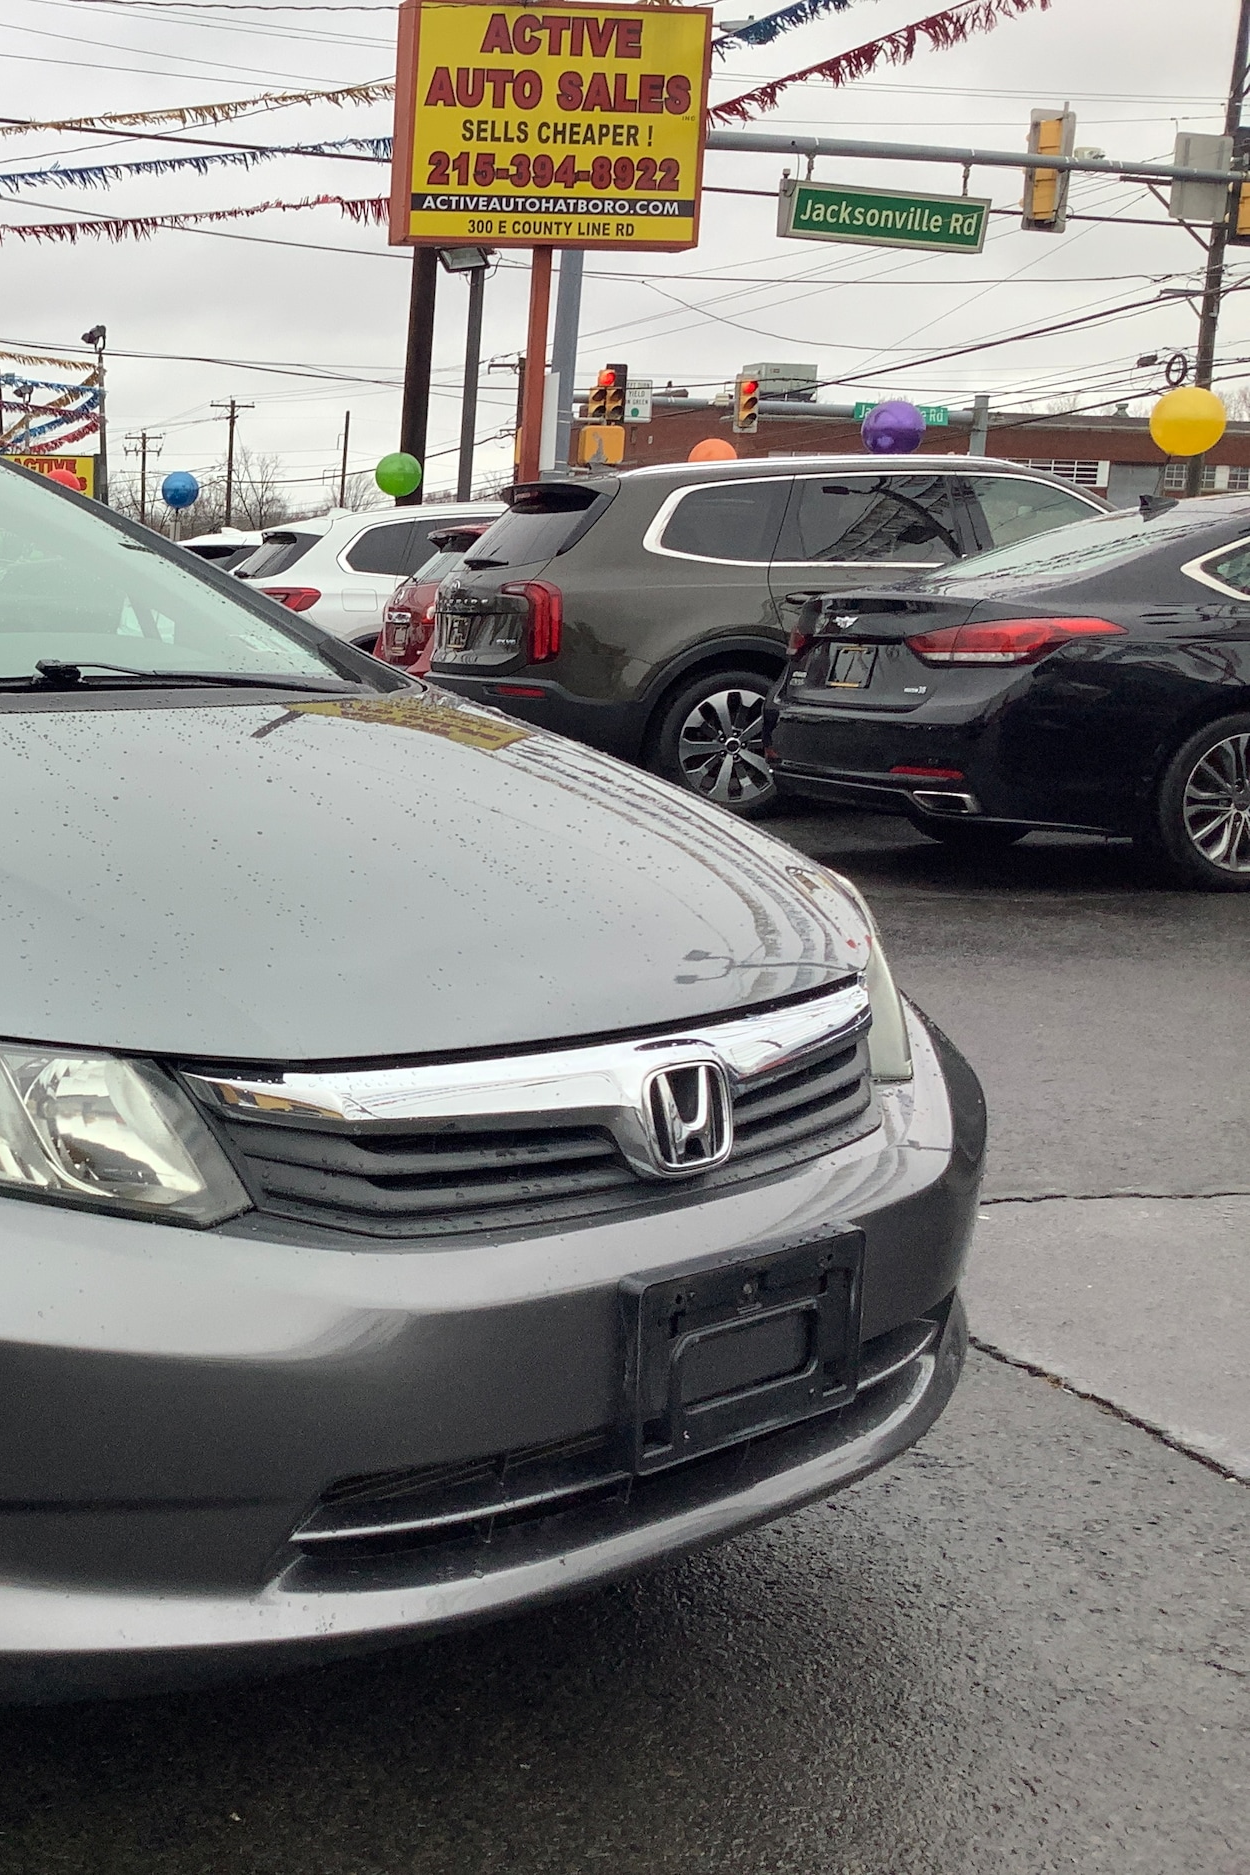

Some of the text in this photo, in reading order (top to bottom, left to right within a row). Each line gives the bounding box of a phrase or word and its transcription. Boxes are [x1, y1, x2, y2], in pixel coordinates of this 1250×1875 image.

[480, 13, 643, 59] ACTIVE
[424, 66, 692, 115] AUTO SALES
[461, 119, 529, 143] SELLS
[537, 122, 639, 146] CHEAPER
[426, 151, 681, 192] 215-394-8922
[422, 194, 680, 215] ACTIVEAUTOHATBORO.COM
[800, 199, 978, 236] Jacksonville Rd
[467, 219, 635, 237] 300 E COUNTY LINE RD
[628, 390, 646, 398] YIELD
[929, 408, 944, 422] Rd
